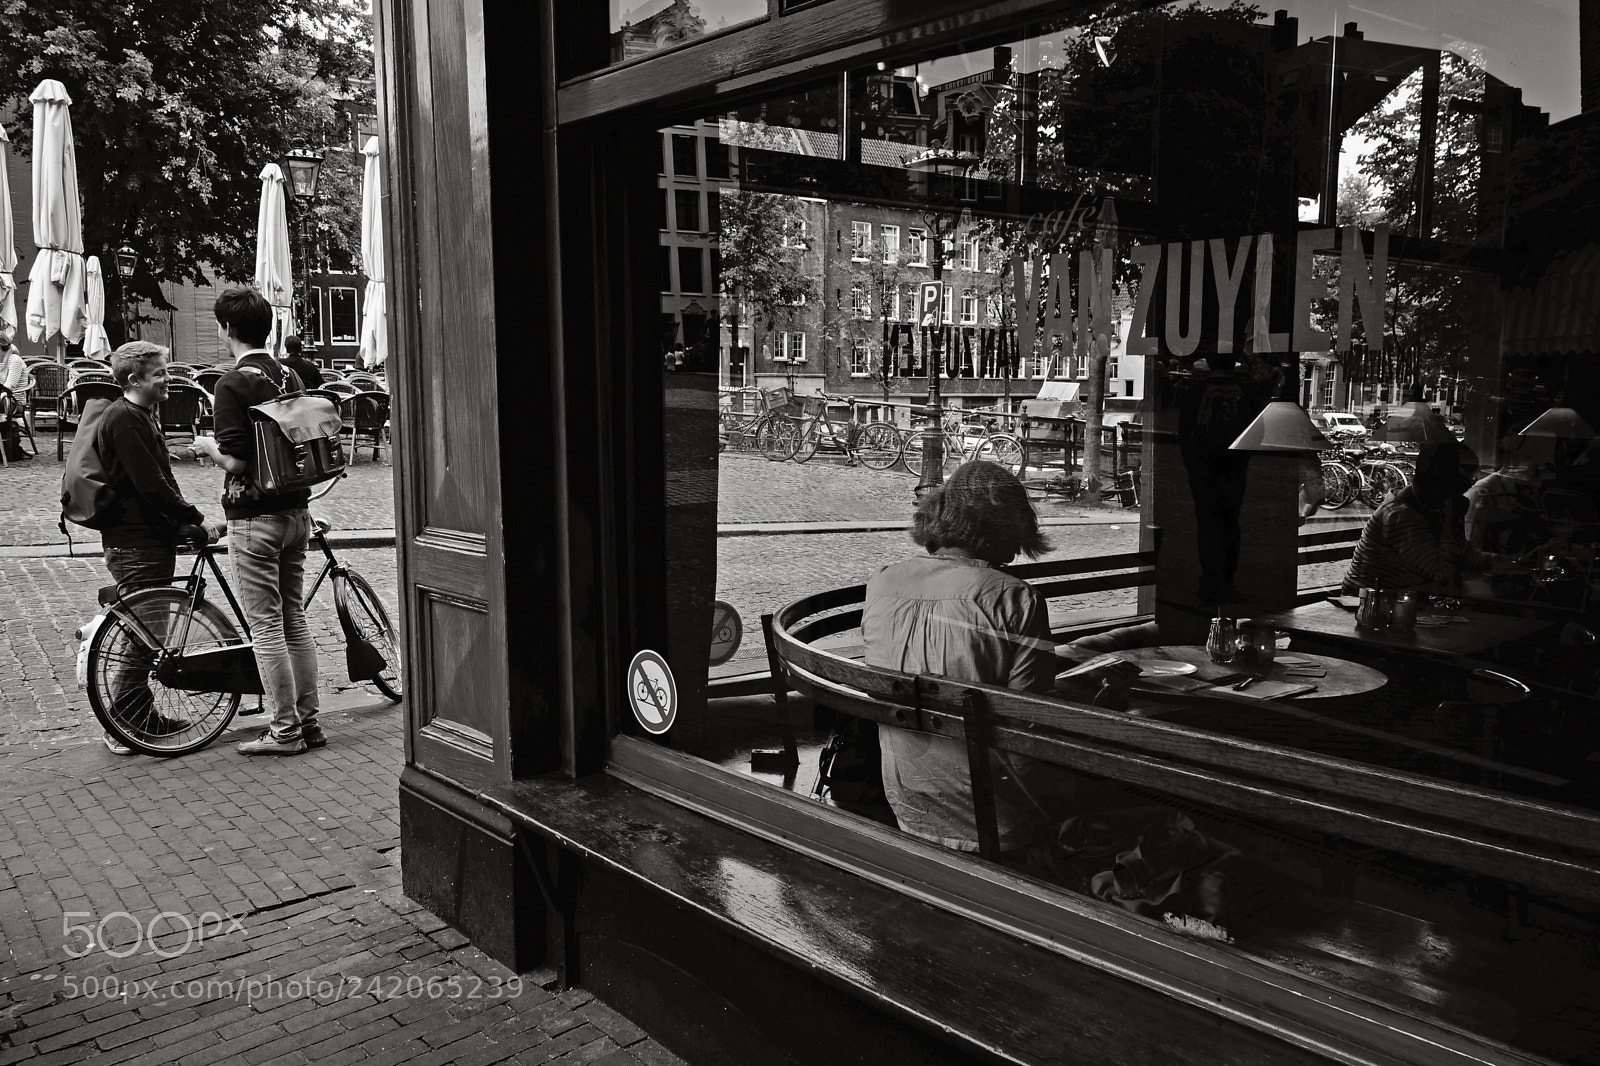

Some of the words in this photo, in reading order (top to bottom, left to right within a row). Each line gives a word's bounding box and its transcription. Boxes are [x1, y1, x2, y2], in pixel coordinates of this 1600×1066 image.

[1025, 188, 1097, 250] café
[923, 285, 938, 312] P
[1011, 247, 1114, 358] VAN
[1125, 225, 1390, 357] ZUYLEN
